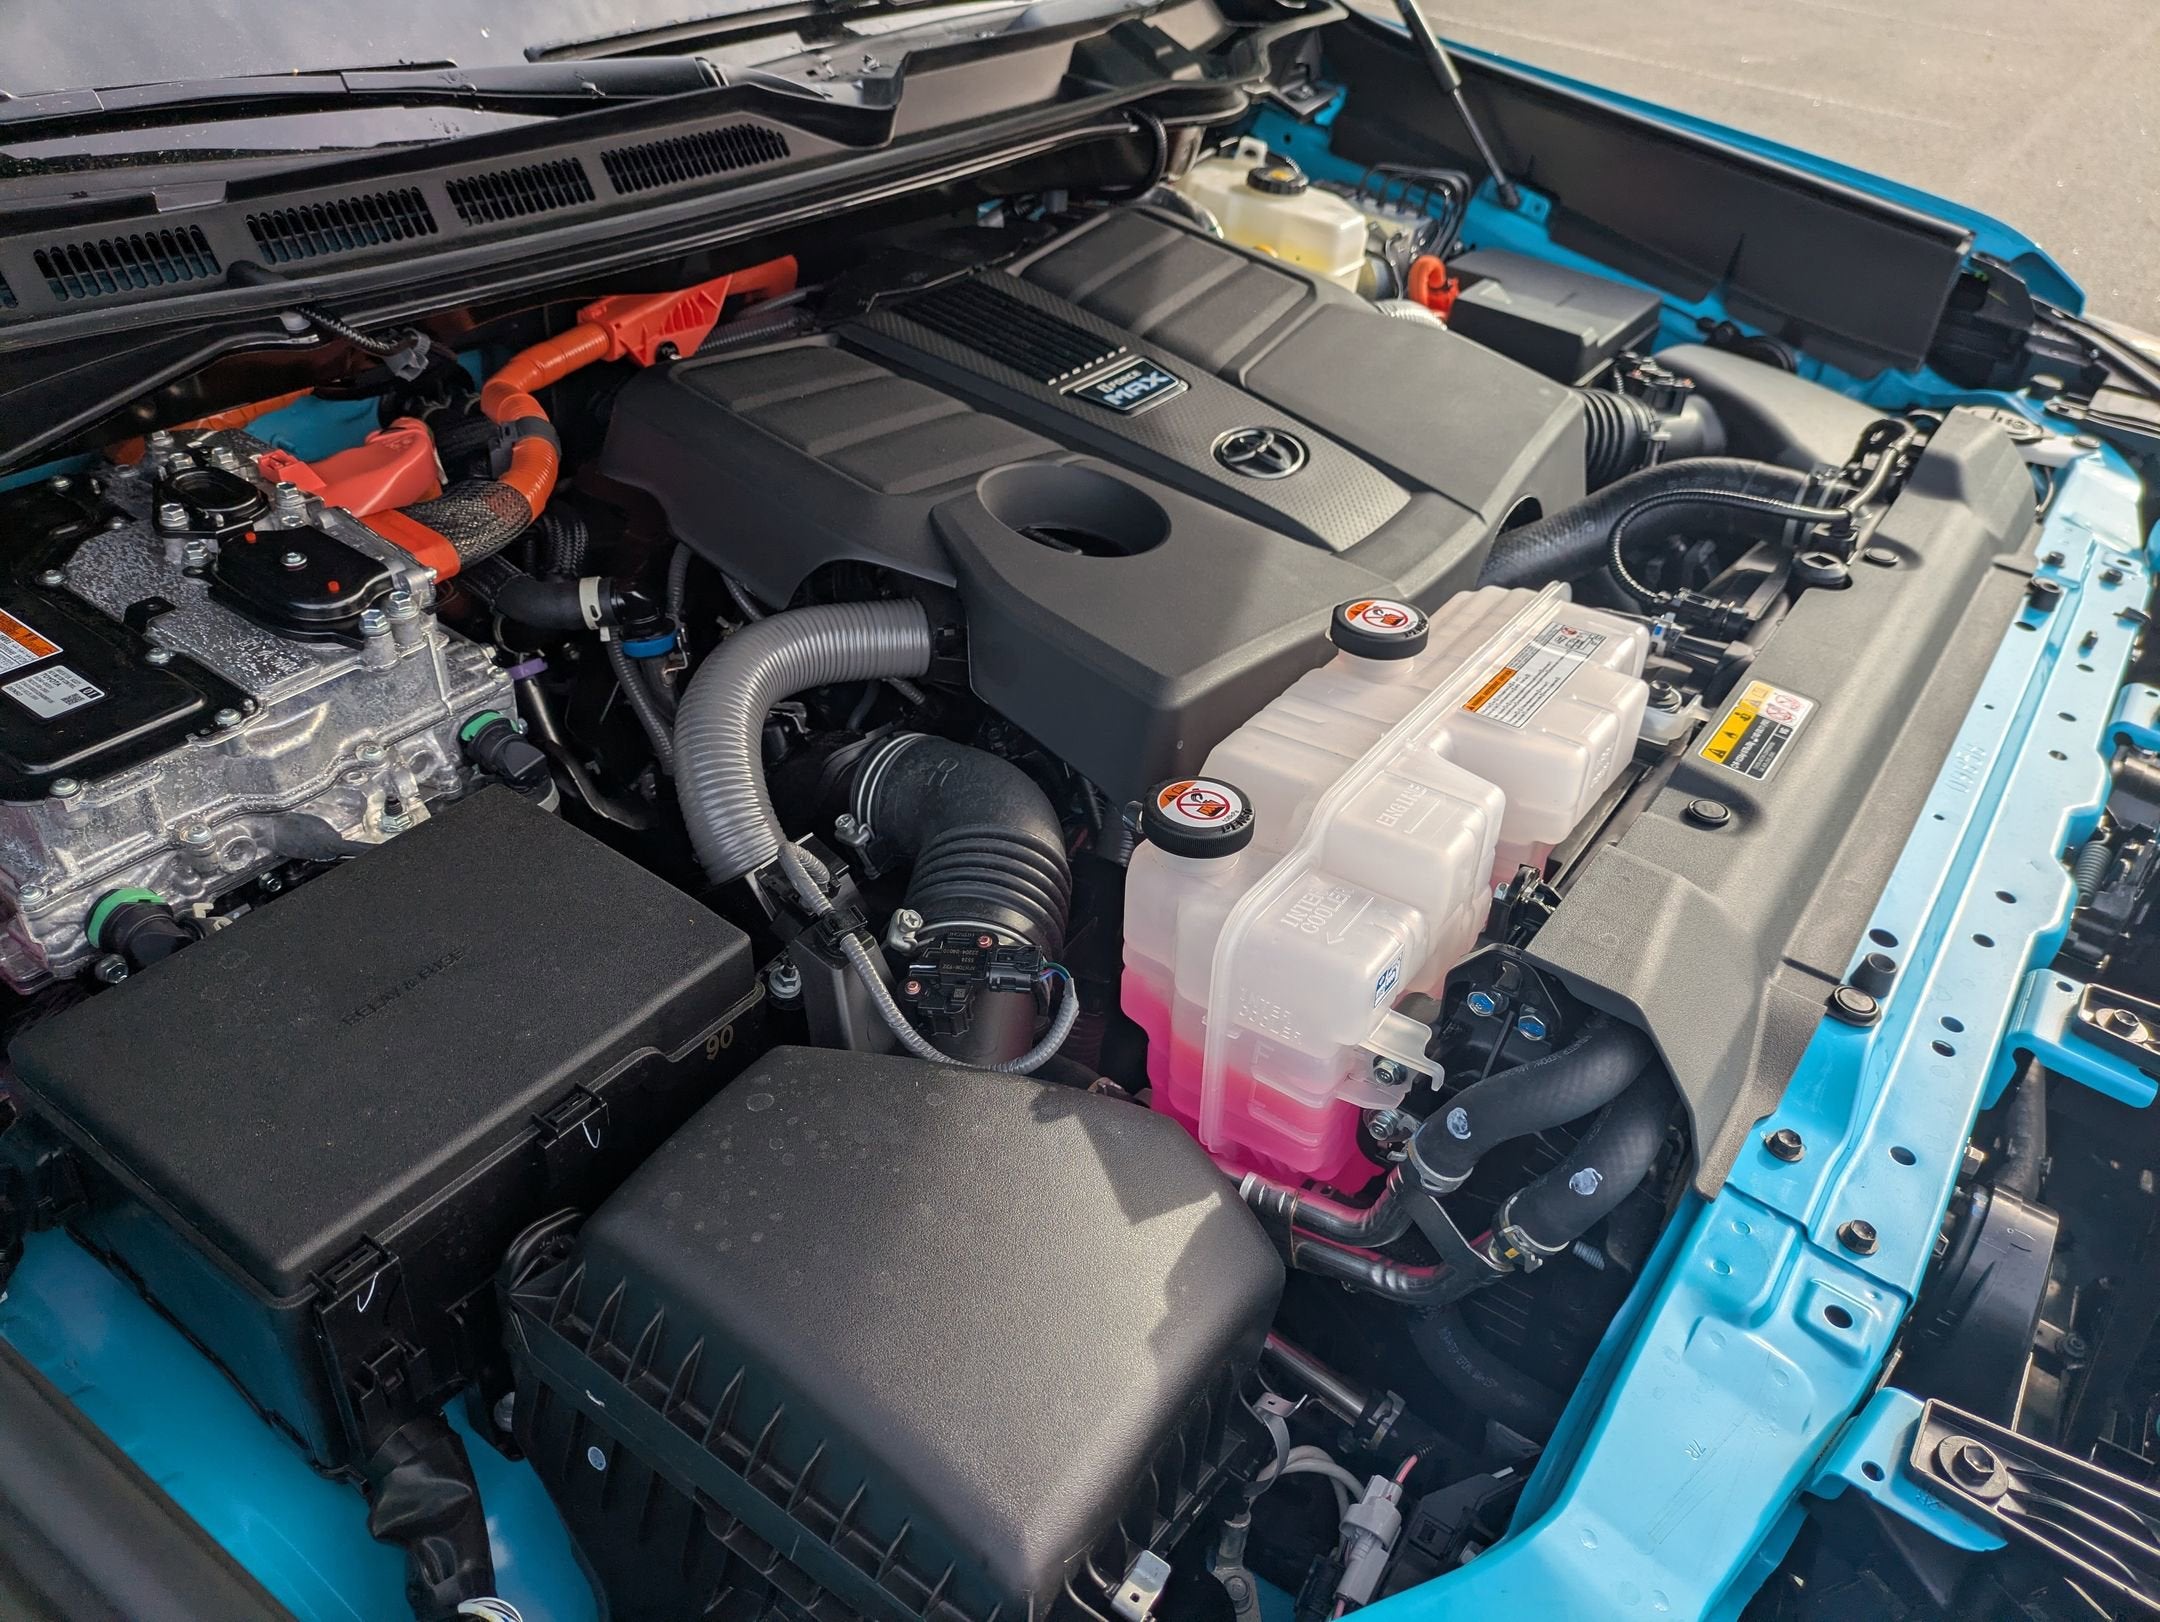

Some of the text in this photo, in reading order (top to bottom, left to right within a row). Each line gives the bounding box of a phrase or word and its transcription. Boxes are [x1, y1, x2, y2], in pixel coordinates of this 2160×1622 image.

[1103, 371, 1170, 405] MAX
[1221, 808, 1253, 833] DENSO
[1375, 783, 1427, 828] ENGINE
[1280, 888, 1325, 928] INTER
[1300, 888, 1355, 934] COOLER
[706, 1024, 734, 1061] 90
